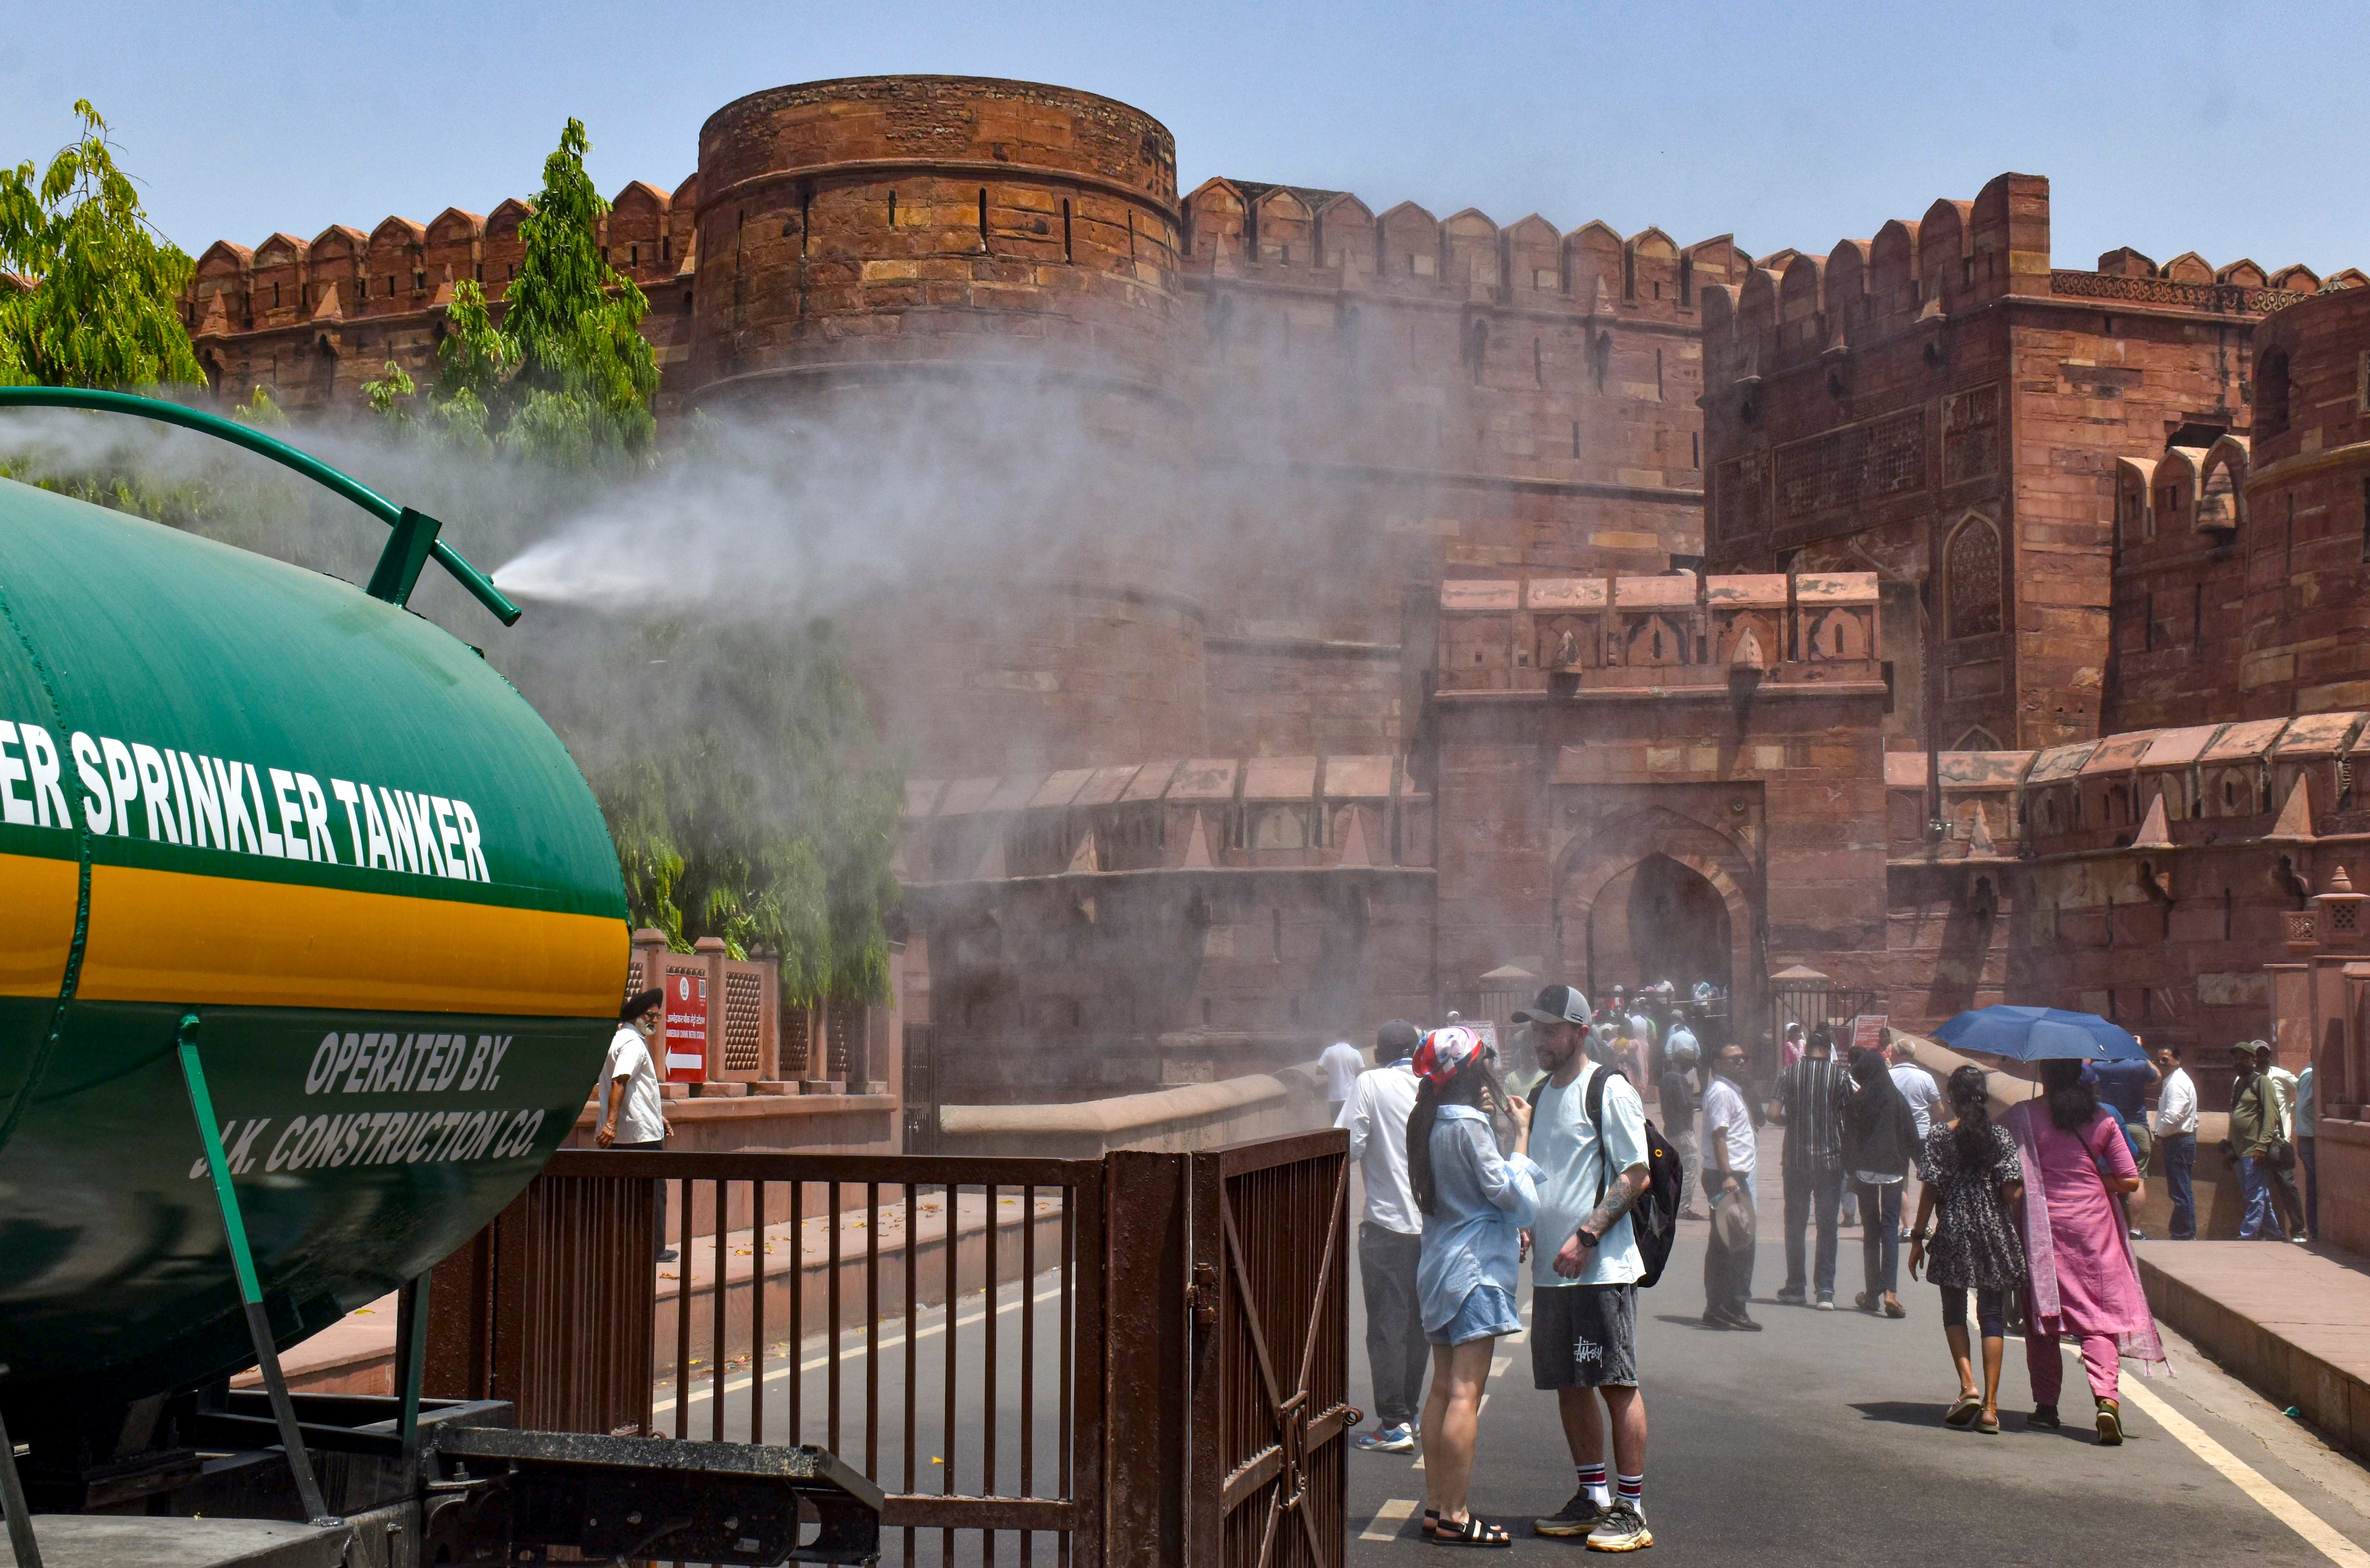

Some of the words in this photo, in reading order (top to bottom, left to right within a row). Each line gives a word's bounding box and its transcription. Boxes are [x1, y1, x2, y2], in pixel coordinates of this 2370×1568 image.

[0, 720, 73, 829] ER
[71, 731, 338, 864] SPRINKLER
[330, 778, 491, 883] TANKER
[305, 1032, 466, 1095] OPERATED
[459, 1035, 513, 1091] BY.
[265, 1111, 509, 1173] CONSTRUCTION
[493, 1109, 545, 1159] CO.
